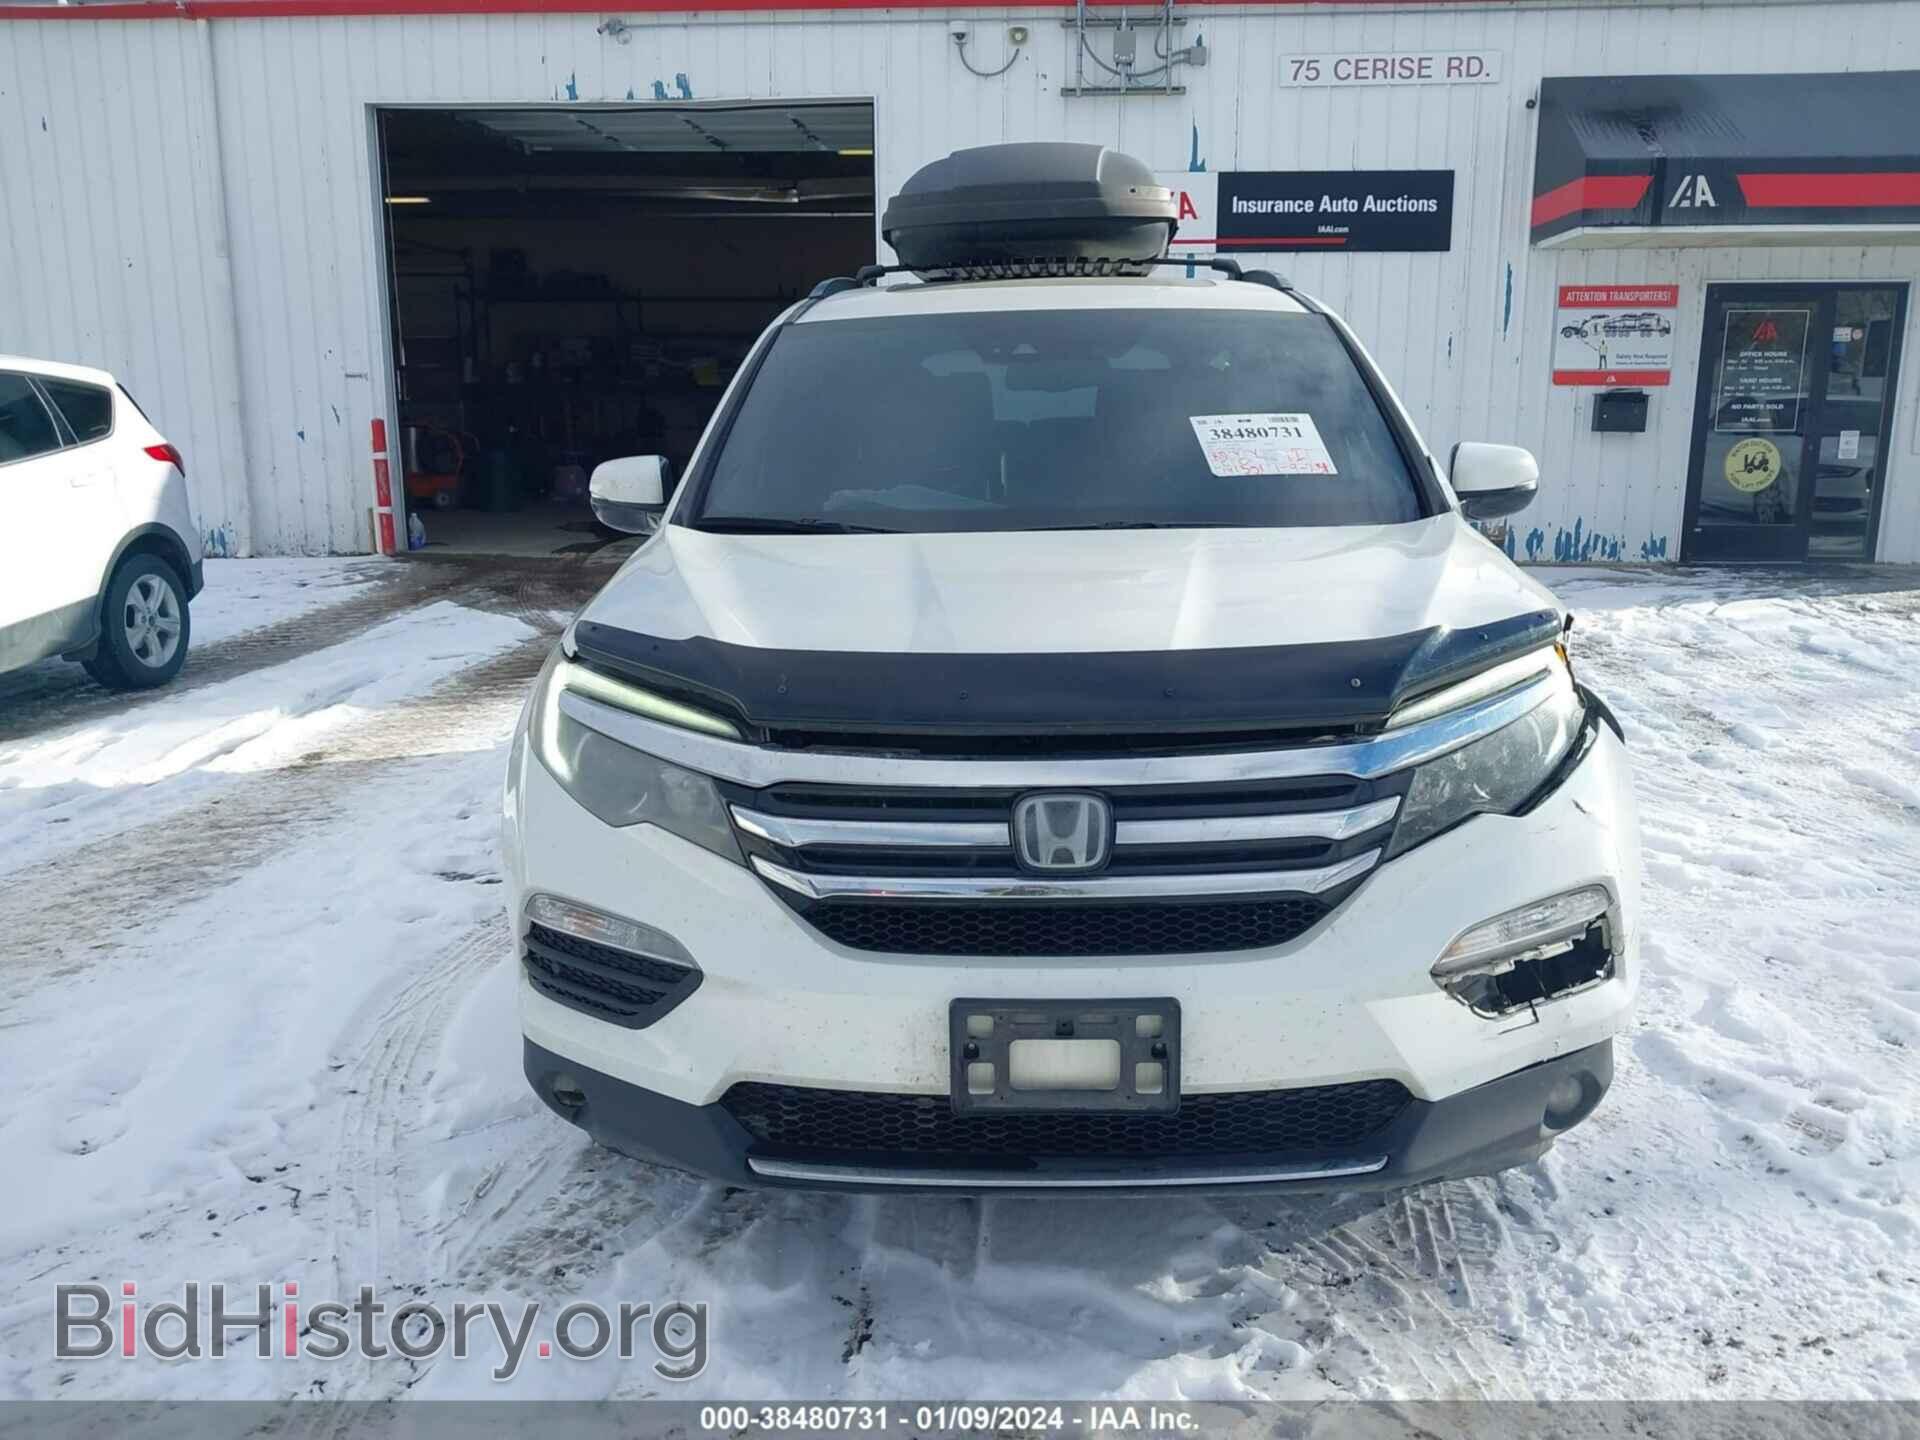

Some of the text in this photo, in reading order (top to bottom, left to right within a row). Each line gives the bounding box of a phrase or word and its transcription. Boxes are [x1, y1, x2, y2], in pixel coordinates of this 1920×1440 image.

[1290, 55, 1490, 81] 75 CERISE RD.
[1232, 195, 1437, 214] Insurance Auto Auctions
[1317, 224, 1349, 234] IAAI.com
[1566, 291, 1607, 302] ATTENTION
[1208, 426, 1303, 441] 38480731
